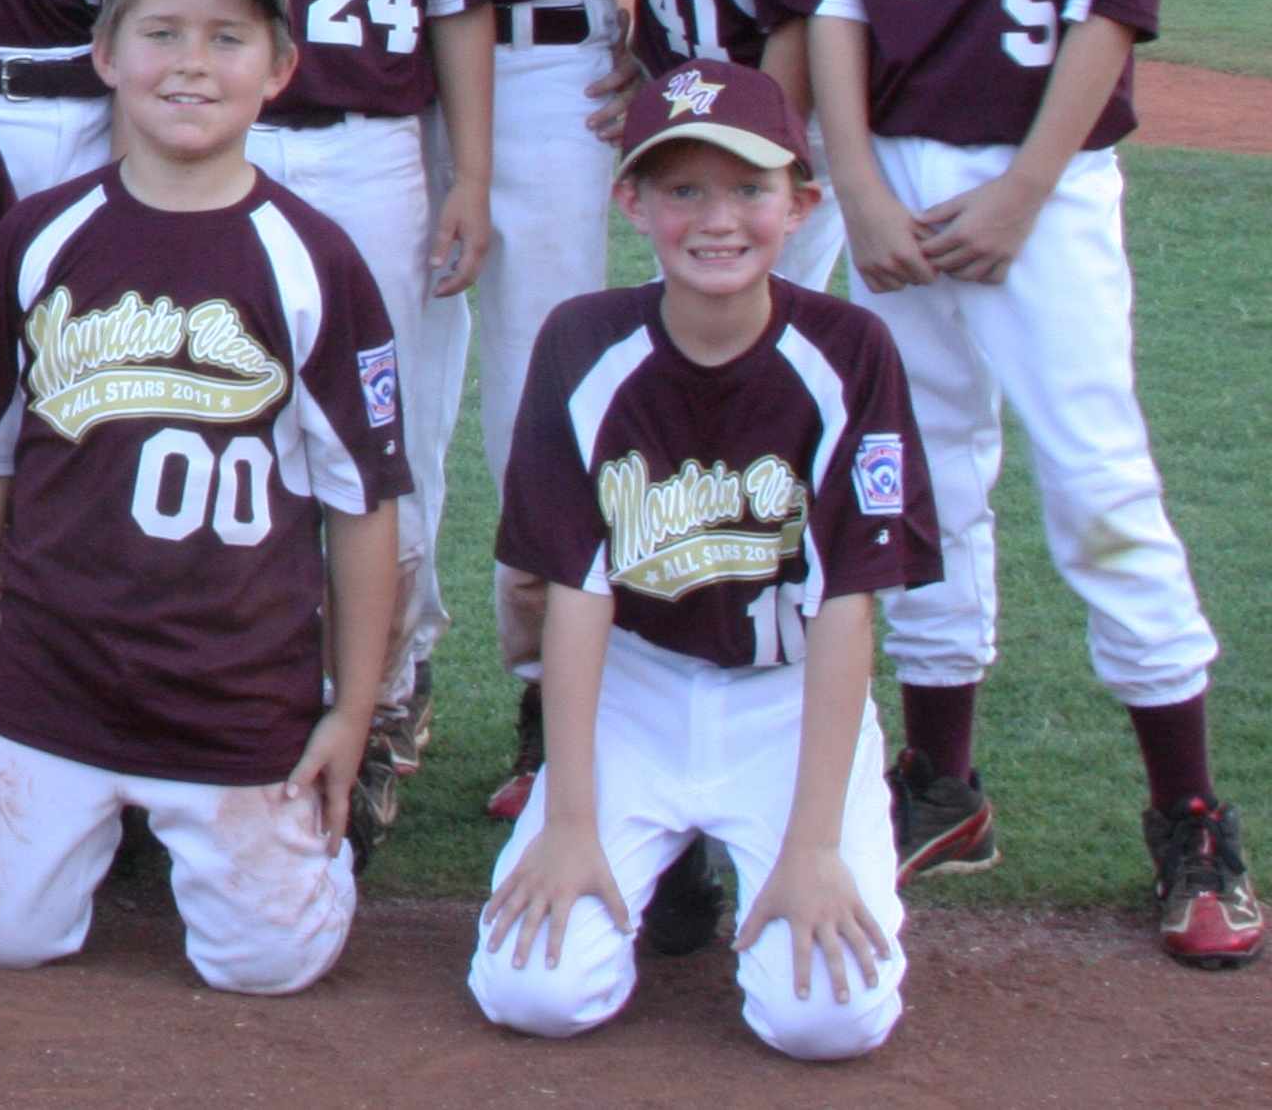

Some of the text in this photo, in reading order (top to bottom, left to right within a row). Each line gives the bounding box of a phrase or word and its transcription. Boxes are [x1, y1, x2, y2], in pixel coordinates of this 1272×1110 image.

[28, 289, 270, 397] Mountain View
[71, 379, 212, 417] ALL STARS 2011
[131, 427, 273, 546] 00
[662, 552, 700, 580] ALL
[704, 544, 741, 566] SARS
